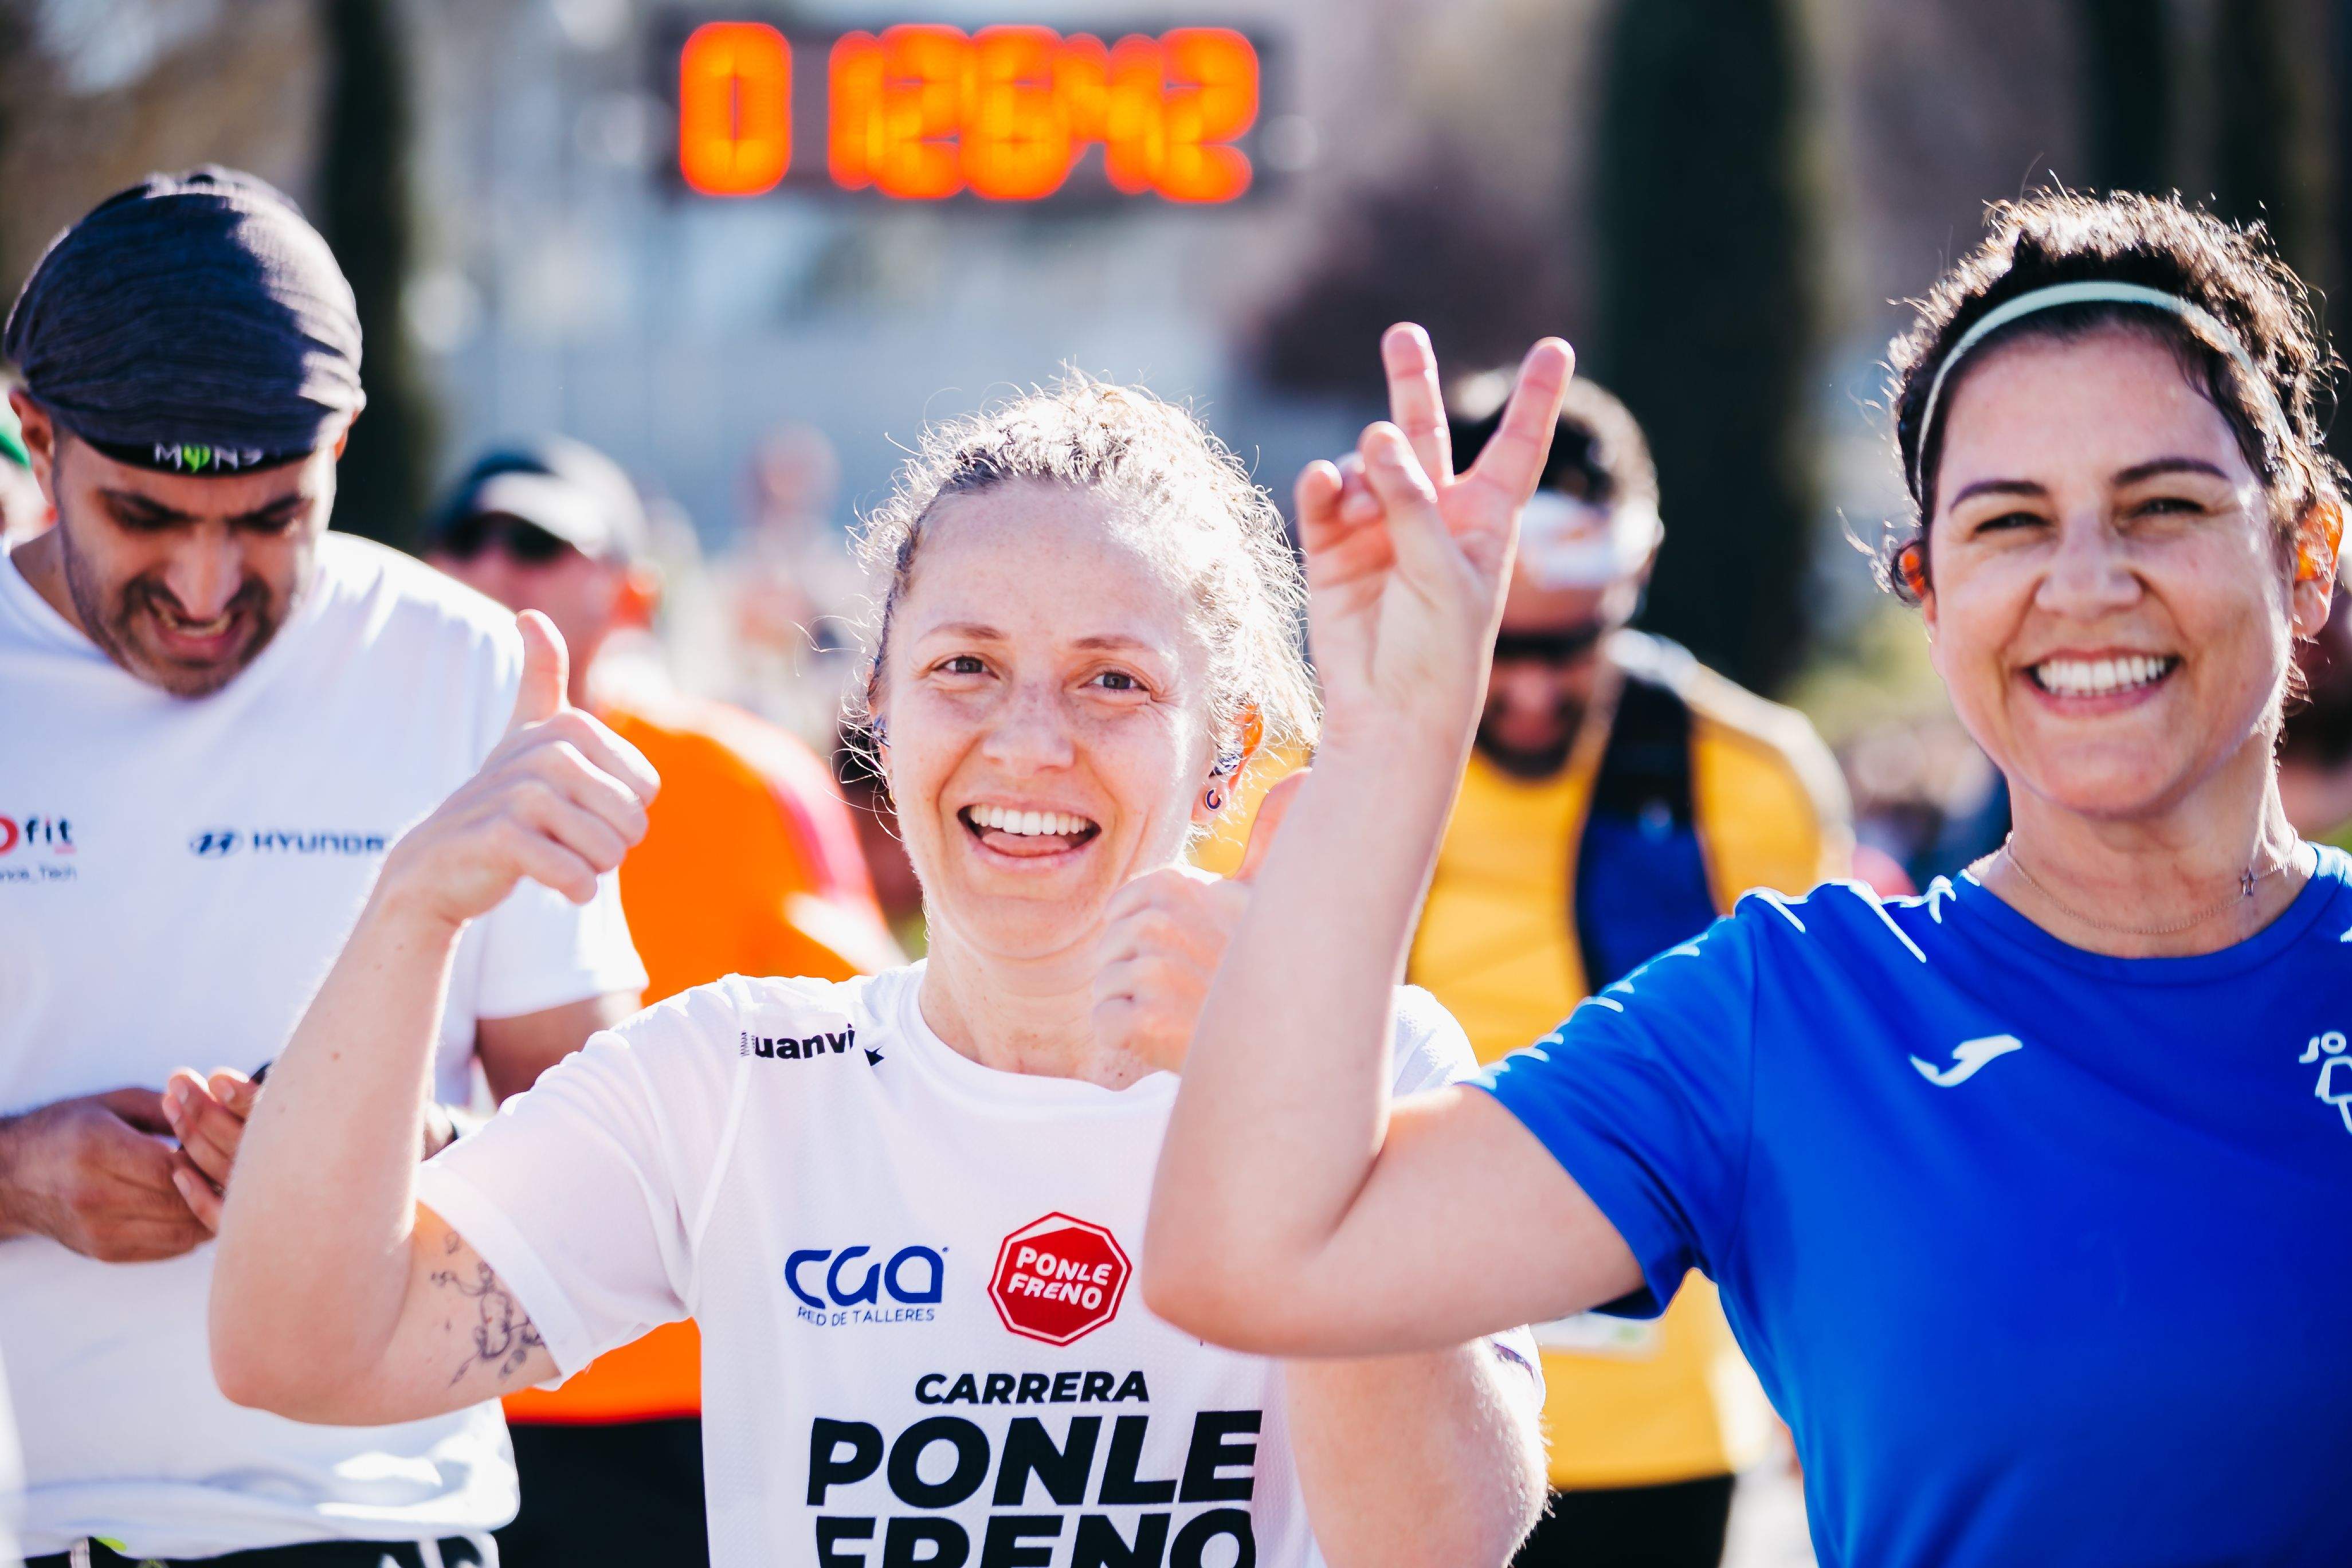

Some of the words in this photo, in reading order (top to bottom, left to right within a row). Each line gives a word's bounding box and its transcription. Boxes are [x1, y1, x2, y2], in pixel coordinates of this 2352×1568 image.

[252, 833, 387, 853] HYUNDA
[1016, 1246, 1113, 1287] PONLE
[1007, 1272, 1103, 1310] FRENO
[797, 1307, 827, 1326] RED
[831, 1311, 848, 1326] DE
[852, 1308, 935, 1323] TALLERES
[915, 1370, 1150, 1405] CARRERA
[806, 1409, 1263, 1510] PONLE
